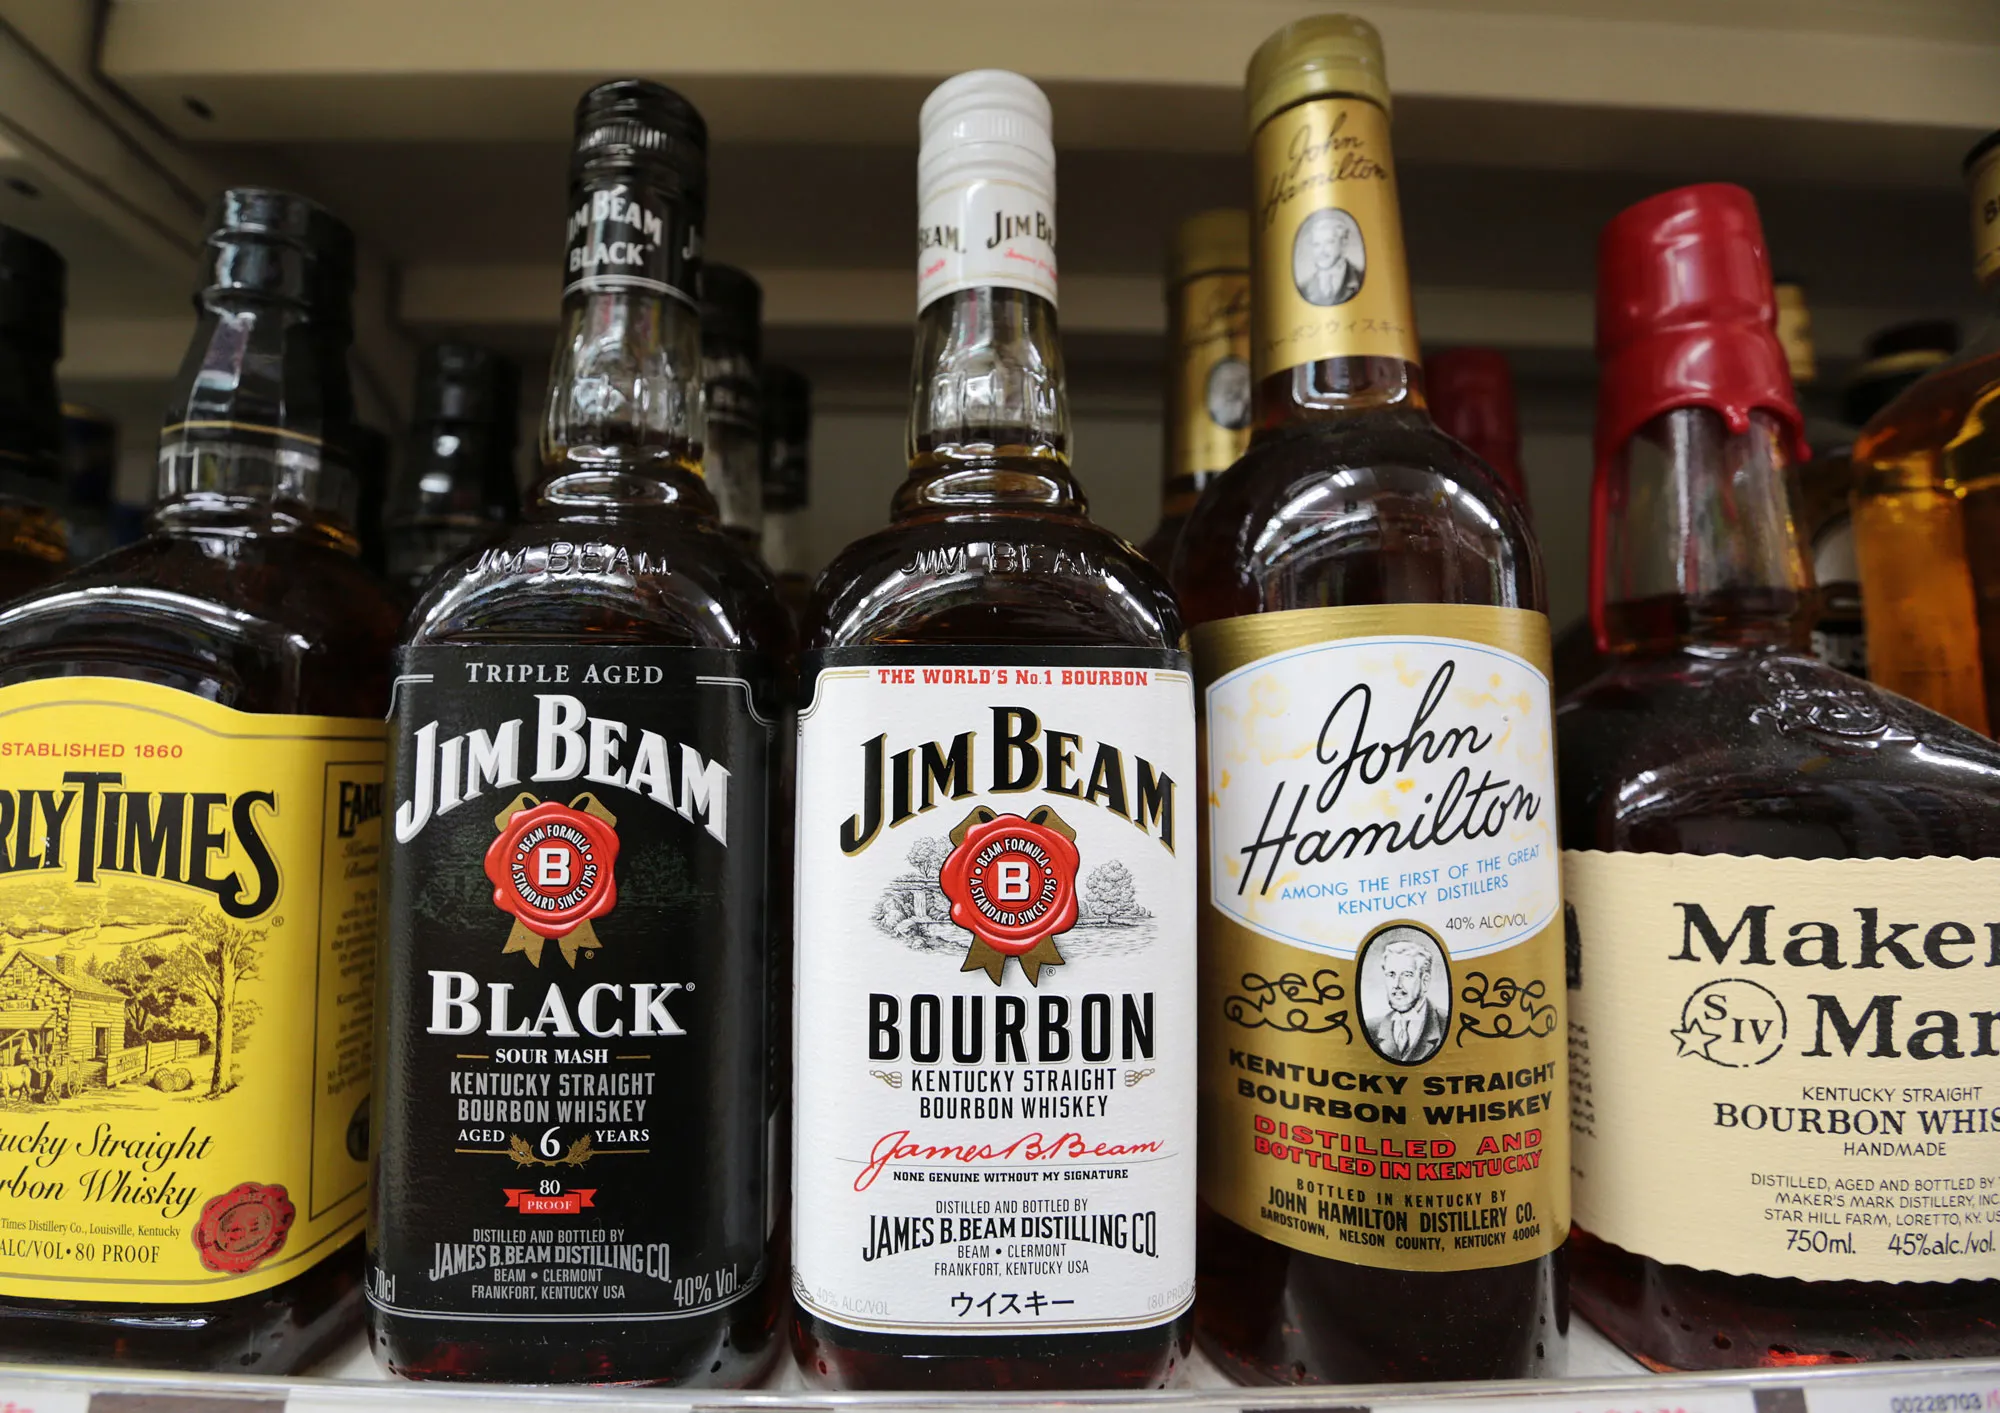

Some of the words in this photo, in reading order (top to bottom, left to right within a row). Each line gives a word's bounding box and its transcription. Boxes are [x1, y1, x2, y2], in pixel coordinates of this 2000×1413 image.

[1288, 111, 1365, 179] John
[1263, 151, 1389, 232] Hamilton
[592, 189, 663, 247] BEAM
[986, 209, 1033, 249] JIM
[570, 241, 644, 273] BLACK
[465, 662, 570, 684] TRIPLE
[581, 663, 664, 684] AGED
[877, 669, 915, 684] THE
[922, 669, 1008, 685] WORLD'S
[1061, 670, 1148, 687] BOURBON
[134, 744, 183, 759] 1860
[1316, 659, 1493, 814] John
[395, 719, 524, 844] JIM
[531, 694, 733, 848] BEAM
[840, 730, 978, 858] JIM
[987, 705, 1178, 859] BEAM
[62, 771, 280, 918] TIMES
[518, 827, 546, 853] BEAM
[546, 824, 592, 854] FORMULA
[1237, 766, 1542, 896] Hamilton
[537, 847, 572, 886] B
[976, 841, 1004, 867] BEAM
[1004, 838, 1051, 868] FORMULA
[512, 872, 556, 911] STANDARD
[557, 887, 588, 910] SINCE
[580, 863, 598, 889] 1795
[997, 861, 1031, 902] B
[1280, 881, 1349, 901] AMONG
[1358, 876, 1390, 894] THE
[1399, 869, 1439, 889] FIRST
[1448, 863, 1470, 881] OF
[1476, 857, 1502, 875] THE
[1507, 844, 1542, 868] GREAT
[970, 886, 1016, 926] STANDARD
[1017, 904, 1047, 926] SINCE
[1042, 877, 1058, 904] 1795
[1337, 891, 1428, 916] KENTUCKY
[1437, 875, 1509, 903] DISTILLERS
[1445, 916, 1475, 931] 40%
[1479, 913, 1529, 929] ALC/VOL
[426, 970, 688, 1038] BLACK
[1703, 993, 1728, 1021] S
[868, 992, 1157, 1065] BOURBON
[495, 1048, 548, 1065] SOUR
[554, 1049, 609, 1065] MASH
[1229, 1048, 1408, 1096] KENTUCKY
[1423, 1061, 1556, 1096] STRAIGHT
[450, 1071, 552, 1096] KENTUCKY
[559, 1072, 656, 1097] STRAIGHT
[911, 1069, 1015, 1092] KENTUCKY
[1023, 1068, 1117, 1092] STRAIGHT
[1802, 1086, 1896, 1102] KENTUCKY
[1902, 1086, 1983, 1103] STRAIGHT
[457, 1098, 550, 1123] BOURBON
[556, 1099, 647, 1123] WHISKEY
[920, 1096, 1014, 1119] BOURBON
[1021, 1095, 1109, 1118] WHISKEY
[1237, 1077, 1407, 1125] BOURBON
[1423, 1090, 1553, 1125] WHISKEY
[1713, 1102, 1906, 1135] BOURBON
[76, 1123, 215, 1173] Straight
[457, 1128, 506, 1143] AGED
[539, 1126, 561, 1158] 6
[594, 1128, 650, 1143] YEARS
[1254, 1113, 1457, 1159] DISTILLED
[1475, 1128, 1543, 1156] AND
[1843, 1142, 1948, 1157] HANDMADE
[854, 1130, 1001, 1192] James
[1254, 1135, 1376, 1177] BOTTLED
[1380, 1161, 1412, 1181] IN
[1416, 1149, 1544, 1182] KENTUCKY
[539, 1179, 561, 1196] 80
[892, 1170, 925, 1182] NONE
[928, 1171, 980, 1183] GENUINE
[984, 1171, 1039, 1183] WITHOUT
[1042, 1171, 1061, 1182] MY
[1063, 1169, 1129, 1181] SIGNATURE
[1751, 1172, 1831, 1191] DISTILLED,
[1834, 1178, 1875, 1192] AGED
[1879, 1179, 1910, 1192] AND
[1914, 1177, 1976, 1192] BOTTLED
[1979, 1175, 1996, 1190] BY
[79, 1168, 203, 1219] Whisky
[526, 1199, 574, 1211] PROOF
[935, 1199, 990, 1214] DISTILLED
[994, 1200, 1018, 1214] AND
[1022, 1199, 1070, 1213] BOTTLED
[1074, 1198, 1089, 1212] BY
[1268, 1186, 1307, 1216] JOHN
[1318, 1200, 1408, 1232] HAMILTON
[1419, 1206, 1508, 1233] DISTILLERY
[1515, 1202, 1537, 1225] CO.
[1297, 1179, 1366, 1203] BOTTLED
[1377, 1193, 1393, 1206] IN
[1404, 1192, 1482, 1208] KENTUCKY
[1491, 1190, 1507, 1203] BY
[1775, 1192, 1846, 1207] MAKER'S
[1850, 1195, 1895, 1209] MARK
[1899, 1194, 1976, 1209] DISTILLERY,
[1, 1217, 26, 1230] Times
[28, 1219, 67, 1236] Distillery
[89, 1223, 135, 1237] Louisville,
[138, 1225, 181, 1239] Kentucky
[1260, 1206, 1330, 1241] BARDSTOWN,
[1339, 1227, 1386, 1248] NELSON
[1395, 1236, 1446, 1252] COUNTY,
[1454, 1232, 1507, 1250] KENTUCKY
[1512, 1224, 1541, 1243] 40004
[1764, 1208, 1804, 1223] STAR
[1808, 1211, 1841, 1225] HILL
[1845, 1212, 1892, 1228] FARM,
[1895, 1212, 1963, 1226] LORETTO,
[473, 1228, 527, 1243] DISTILLED
[530, 1230, 554, 1243] AND
[557, 1229, 606, 1243] BOTTLED
[610, 1229, 625, 1243] BY
[862, 1214, 935, 1262] JAMES
[1021, 1213, 1127, 1249] DISTILLING
[1132, 1211, 1160, 1259] CO.
[957, 1244, 990, 1259] BEAM
[1007, 1243, 1067, 1258] CLERMONT
[1786, 1229, 1857, 1255] 750ml.
[102, 1244, 161, 1263] PROOF
[429, 1243, 487, 1282] JAMES
[554, 1243, 644, 1278] DISTILLING
[645, 1243, 673, 1284] CO.
[934, 1261, 1002, 1277] FRANKFORT,
[1006, 1261, 1064, 1276] KENTUCKY
[1067, 1260, 1090, 1274] USA
[374, 1265, 396, 1303] 70cl
[493, 1268, 526, 1283] BEAM
[543, 1268, 603, 1283] CLERMONT
[673, 1274, 713, 1308] 40%
[471, 1285, 538, 1300] FRANKFORT,
[541, 1285, 599, 1300] KENTUCKY
[603, 1285, 626, 1299] USA
[816, 1287, 839, 1307] 40%
[841, 1295, 892, 1316] ALC/VOL
[950, 1290, 1075, 1318] ウイスキー
